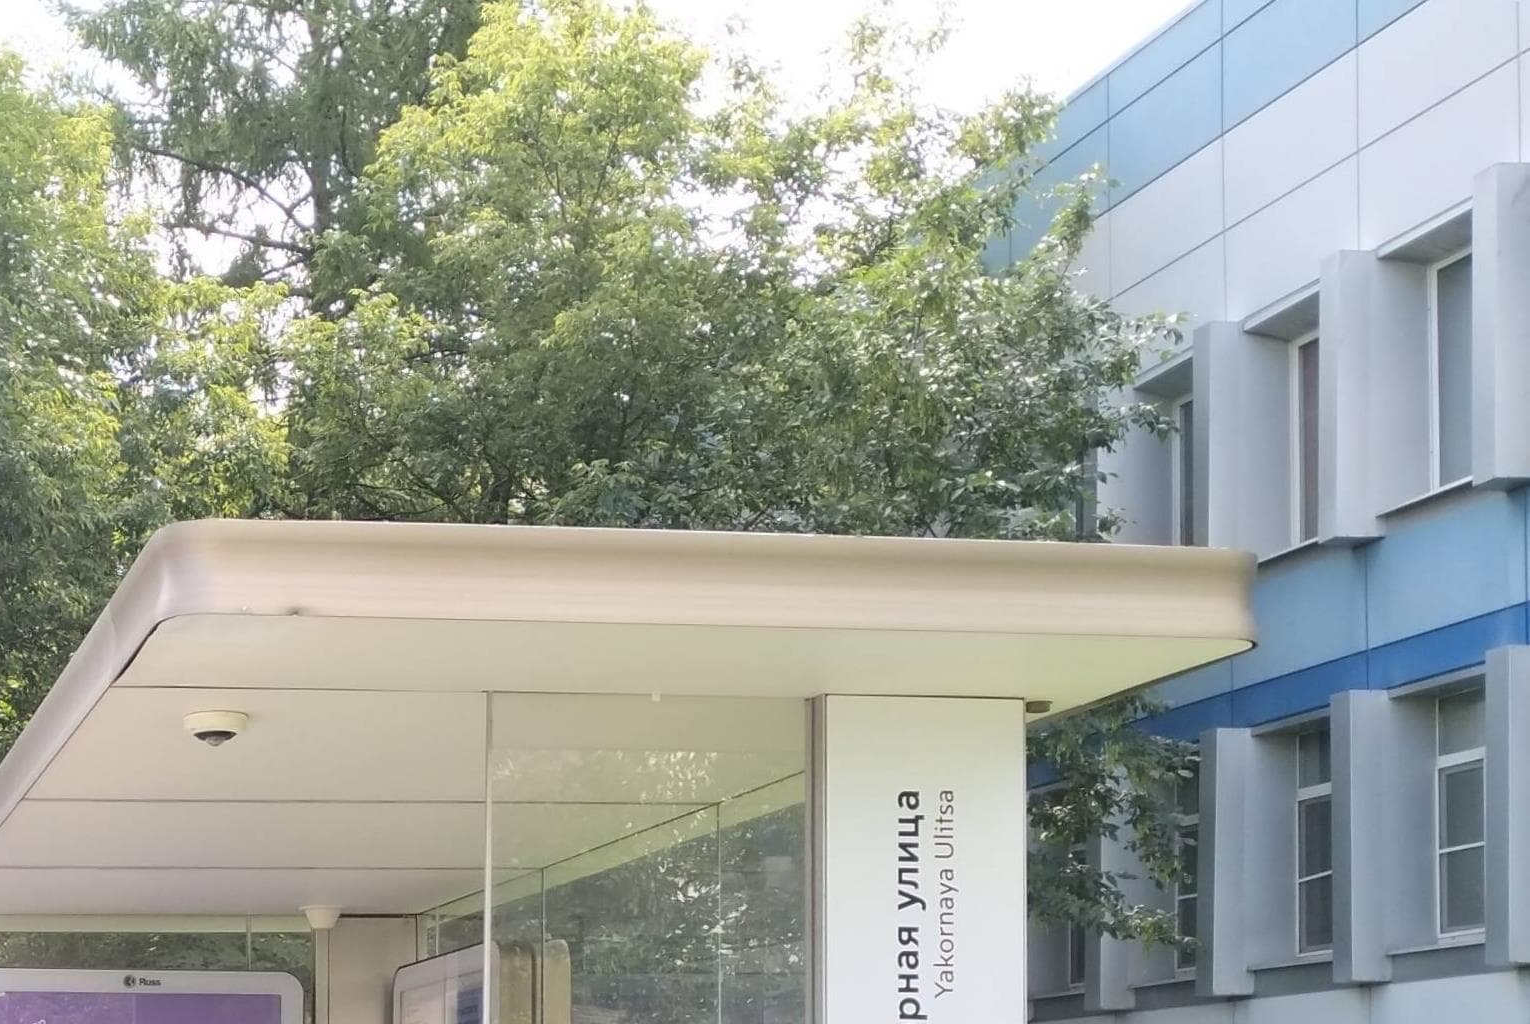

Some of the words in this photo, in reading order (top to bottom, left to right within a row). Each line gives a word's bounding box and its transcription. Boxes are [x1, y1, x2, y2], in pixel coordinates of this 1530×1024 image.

[898, 789, 926, 912] улица
[933, 789, 954, 860] Ulitsa
[933, 868, 959, 999] Yakornaya
